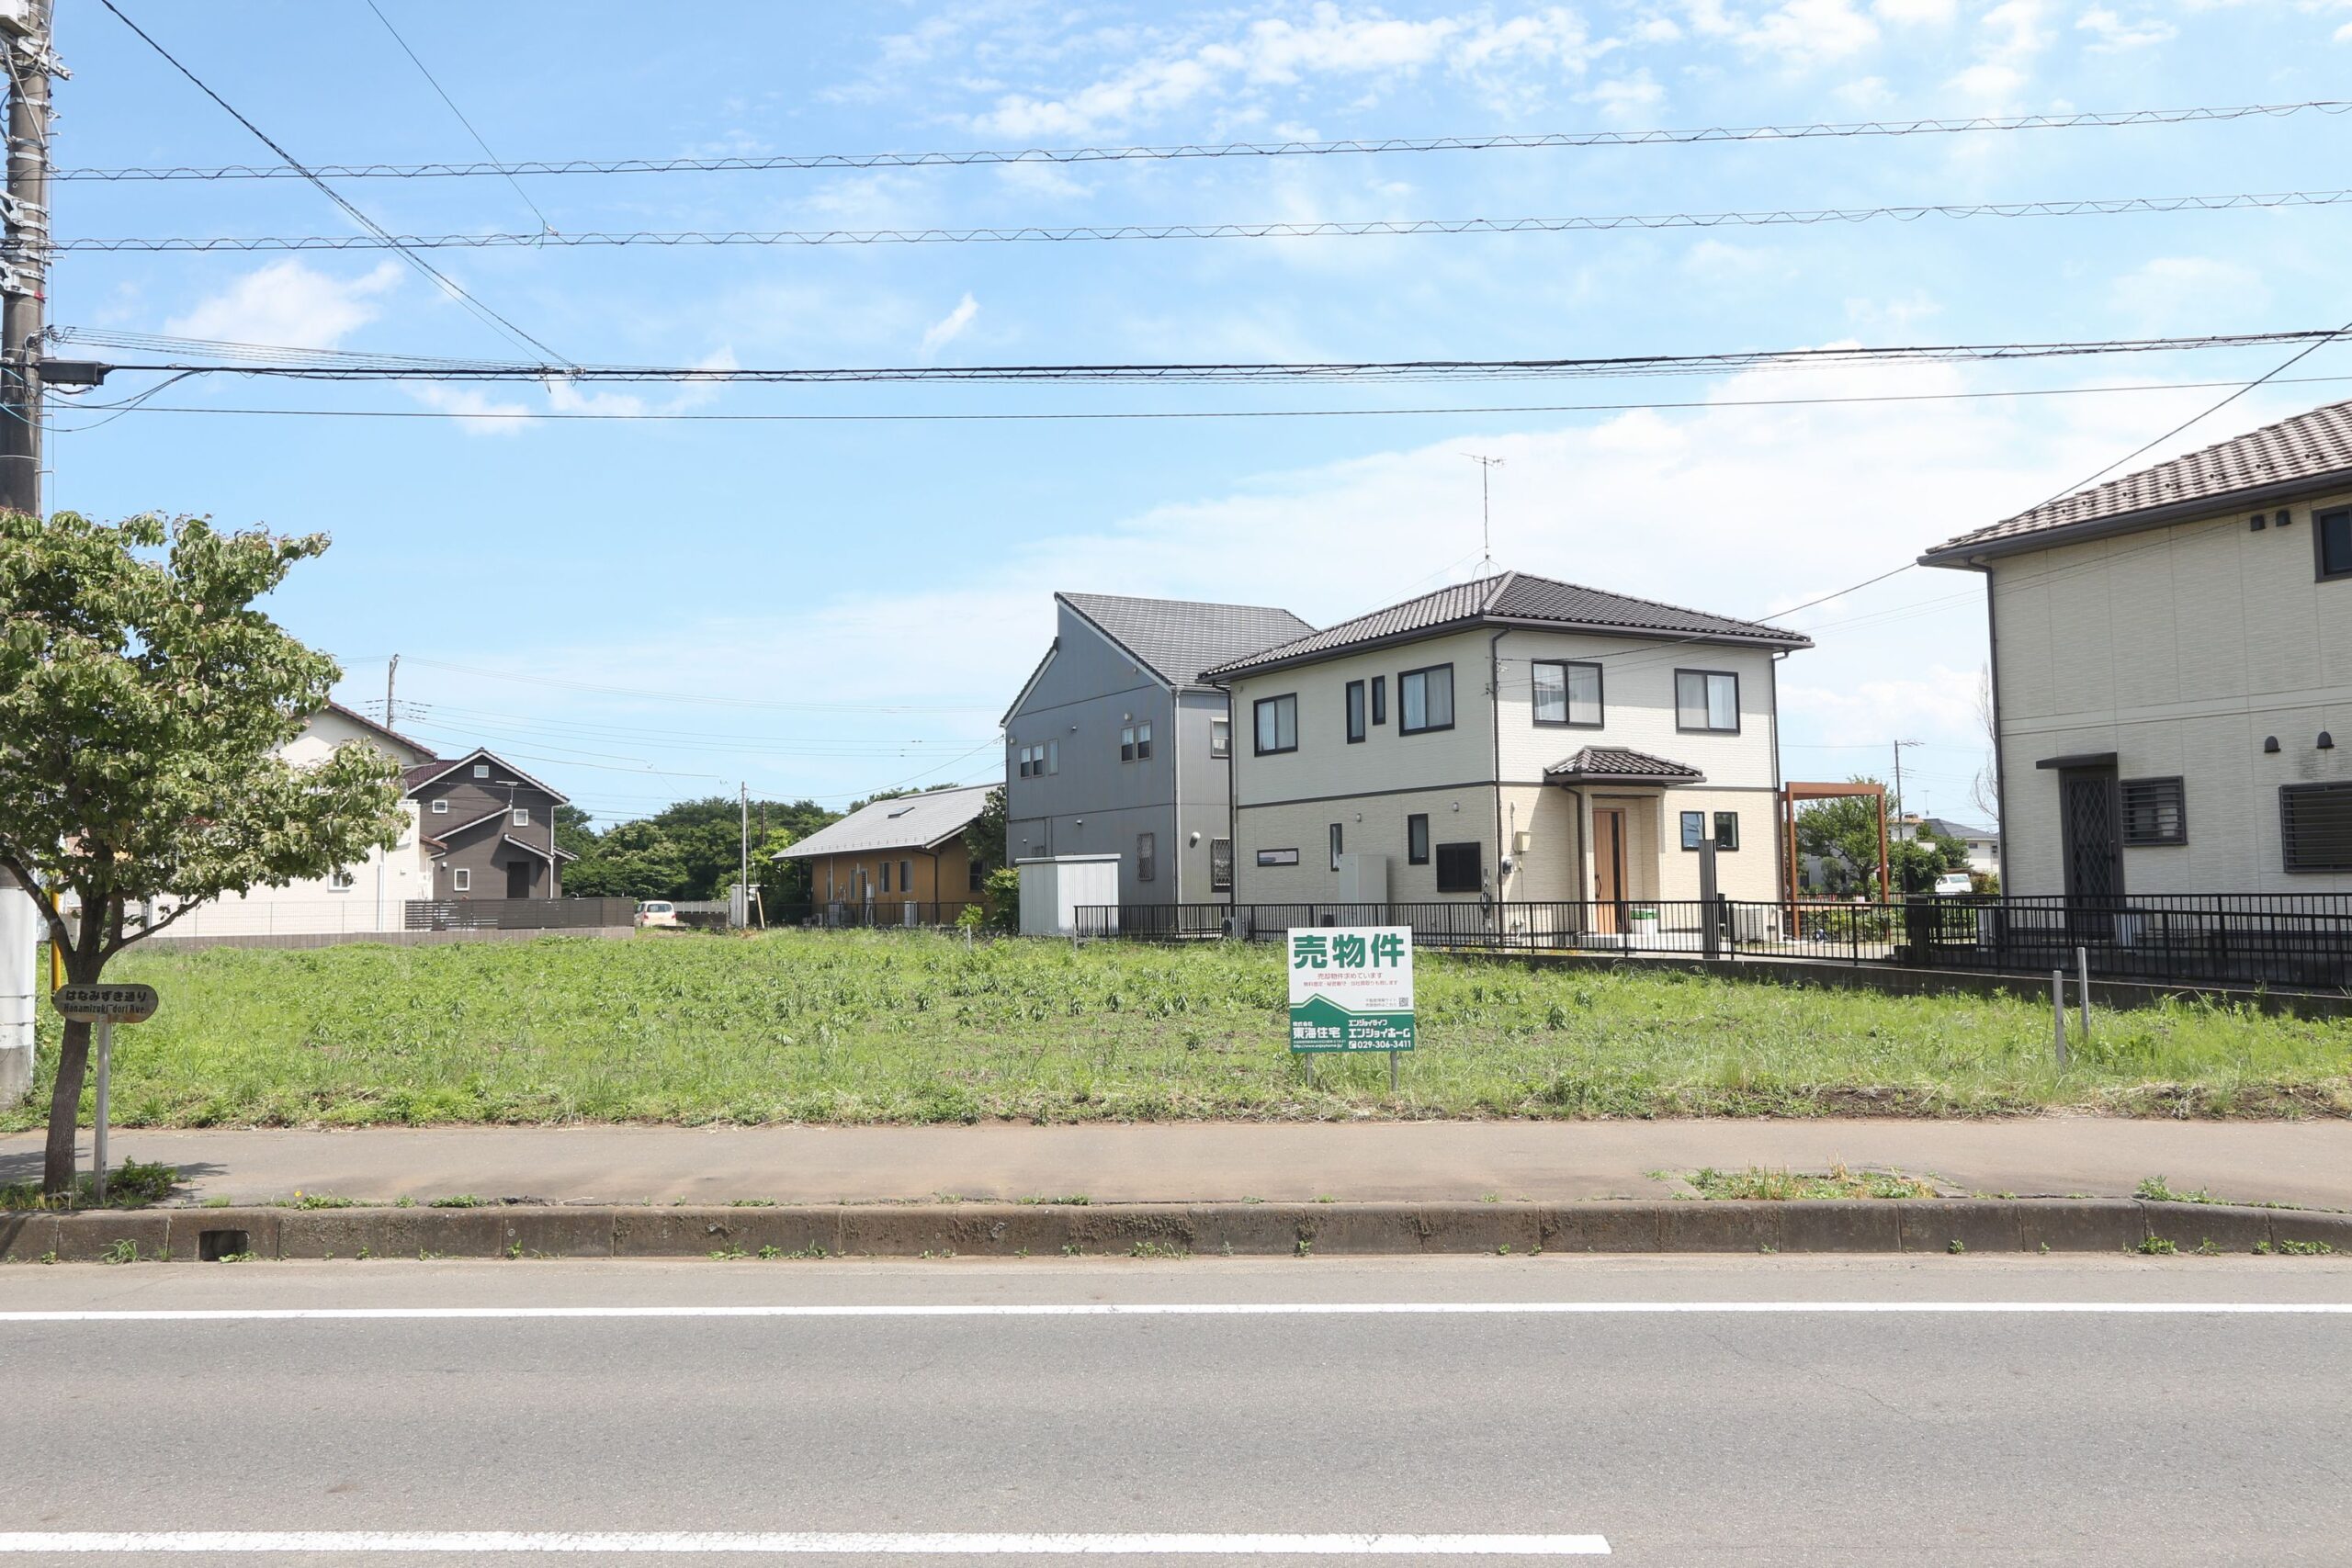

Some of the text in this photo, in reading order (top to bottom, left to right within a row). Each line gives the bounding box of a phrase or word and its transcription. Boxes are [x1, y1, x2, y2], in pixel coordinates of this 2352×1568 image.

[1293, 933, 1405, 969] 売物件
[66, 990, 147, 1001] はなみずき通り
[1293, 1027, 1340, 1039] 東海住宅
[1357, 1040, 1411, 1049] 029-306-3411
